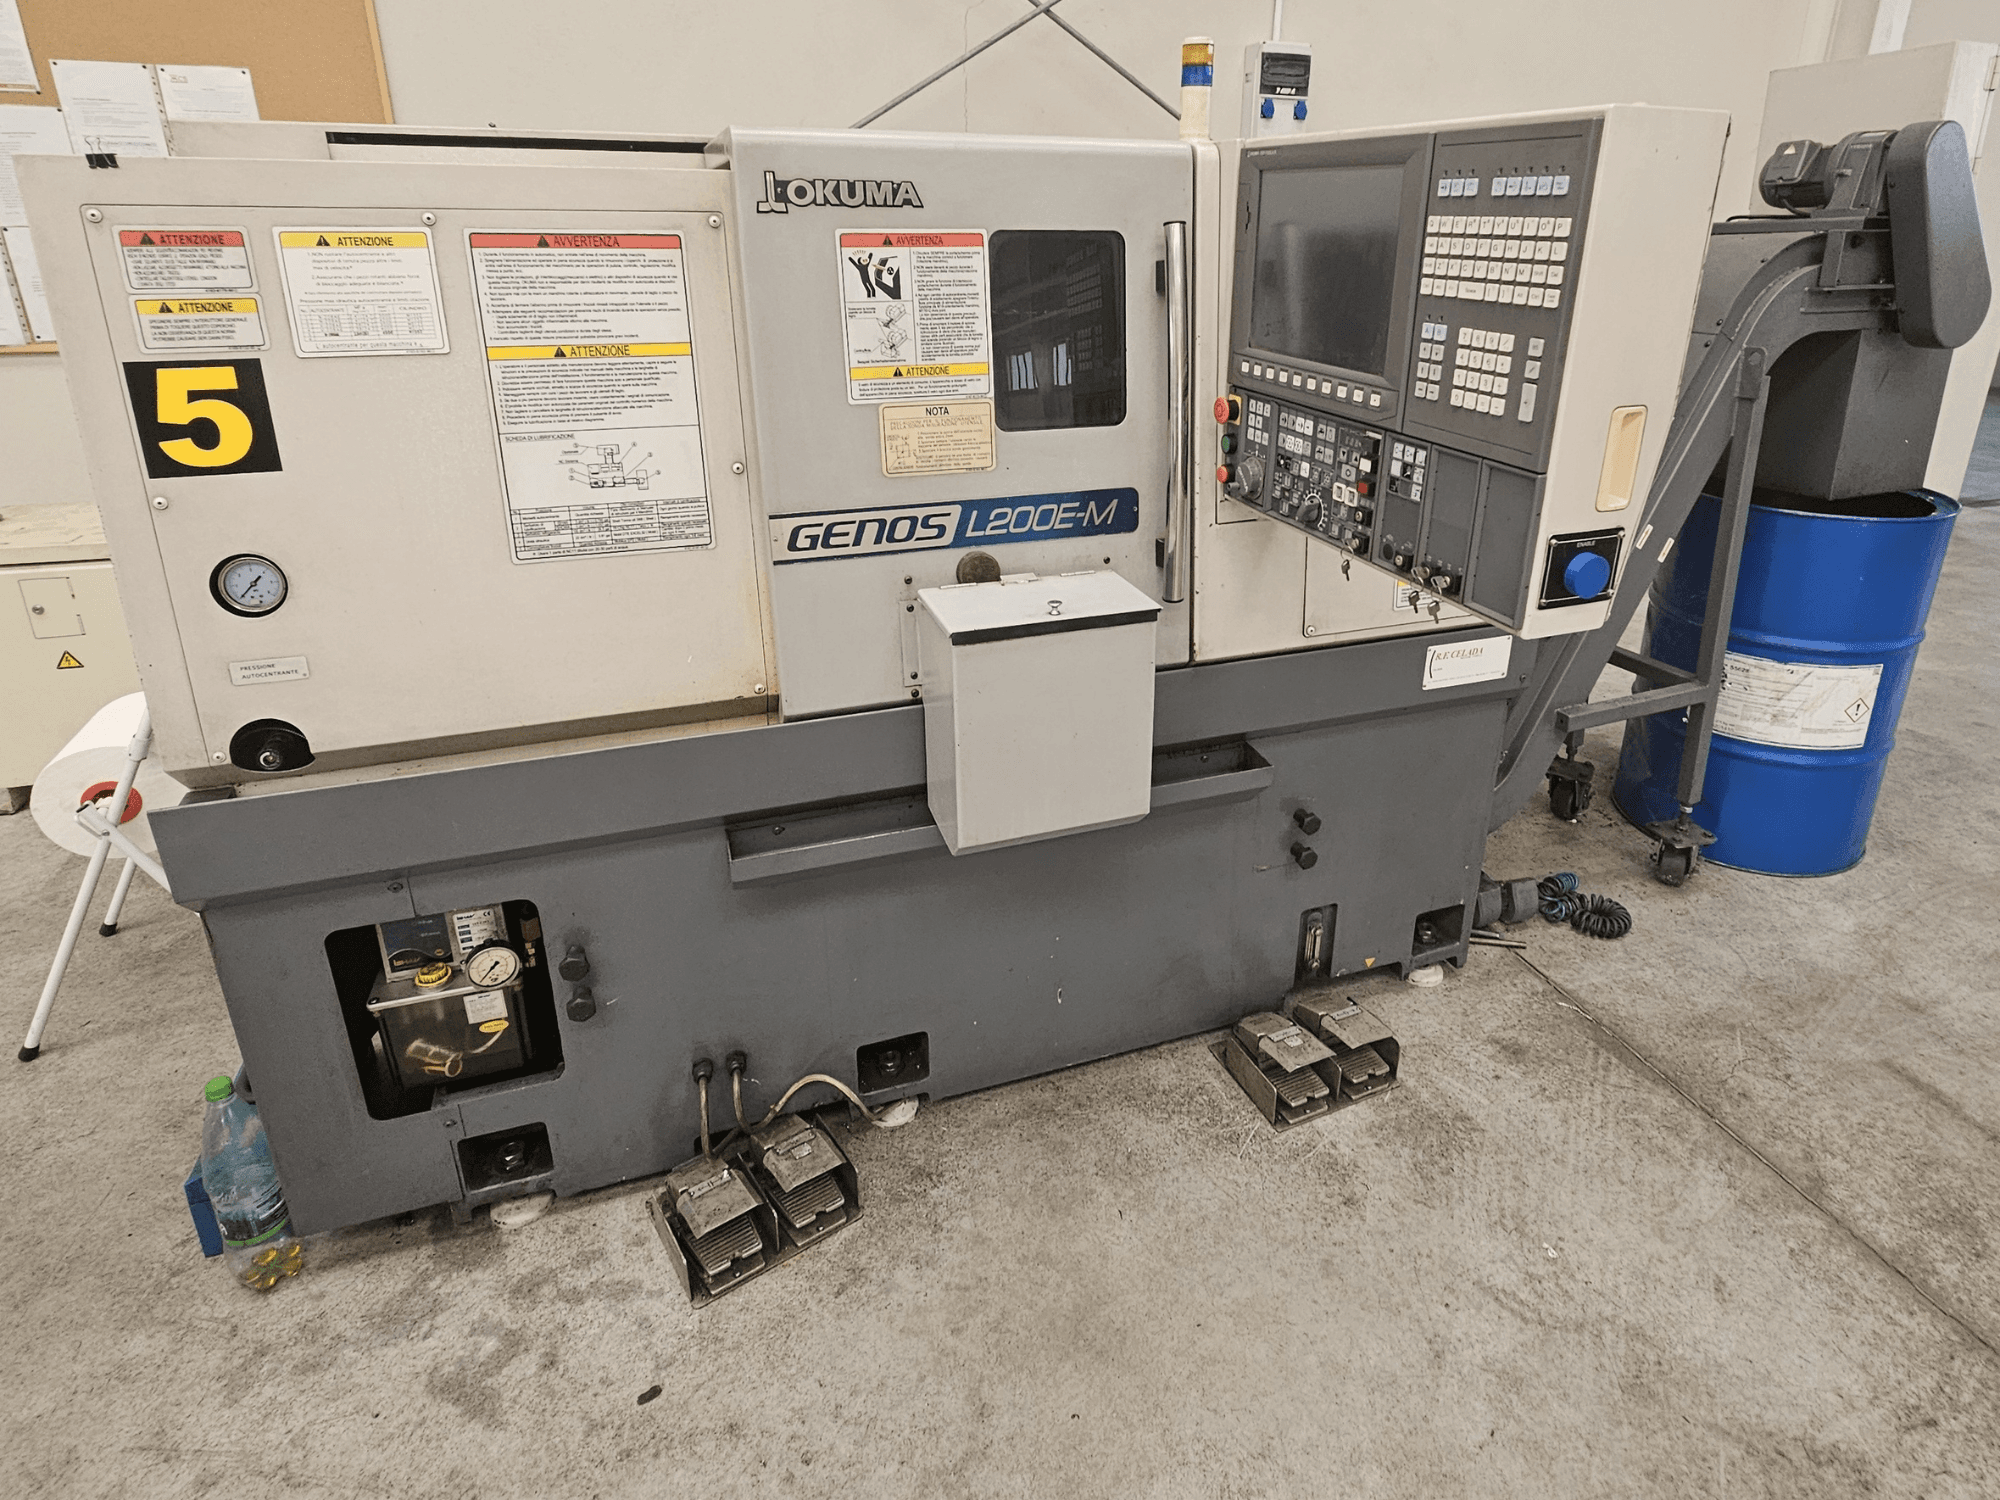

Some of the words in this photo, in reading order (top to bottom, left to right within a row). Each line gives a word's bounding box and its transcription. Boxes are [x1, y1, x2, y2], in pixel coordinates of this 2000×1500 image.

[786, 178, 924, 209] OKUMA
[159, 234, 225, 245] ATTENZIONE
[337, 236, 394, 247] ATTENZIONE
[553, 235, 620, 248] AVVERTENZA
[896, 236, 943, 246] AVVERTENZA
[178, 302, 234, 313] ATTENZIONE
[569, 345, 630, 357] ATTENZIONE
[905, 366, 950, 376] ATTENZIONE
[156, 365, 253, 468] 5
[925, 406, 950, 416] NOTA
[787, 512, 951, 553] GENOS
[965, 498, 1119, 538] L200E-M
[240, 663, 275, 671] PRESSIONE
[241, 669, 299, 680] AUTOCENTRANTE
